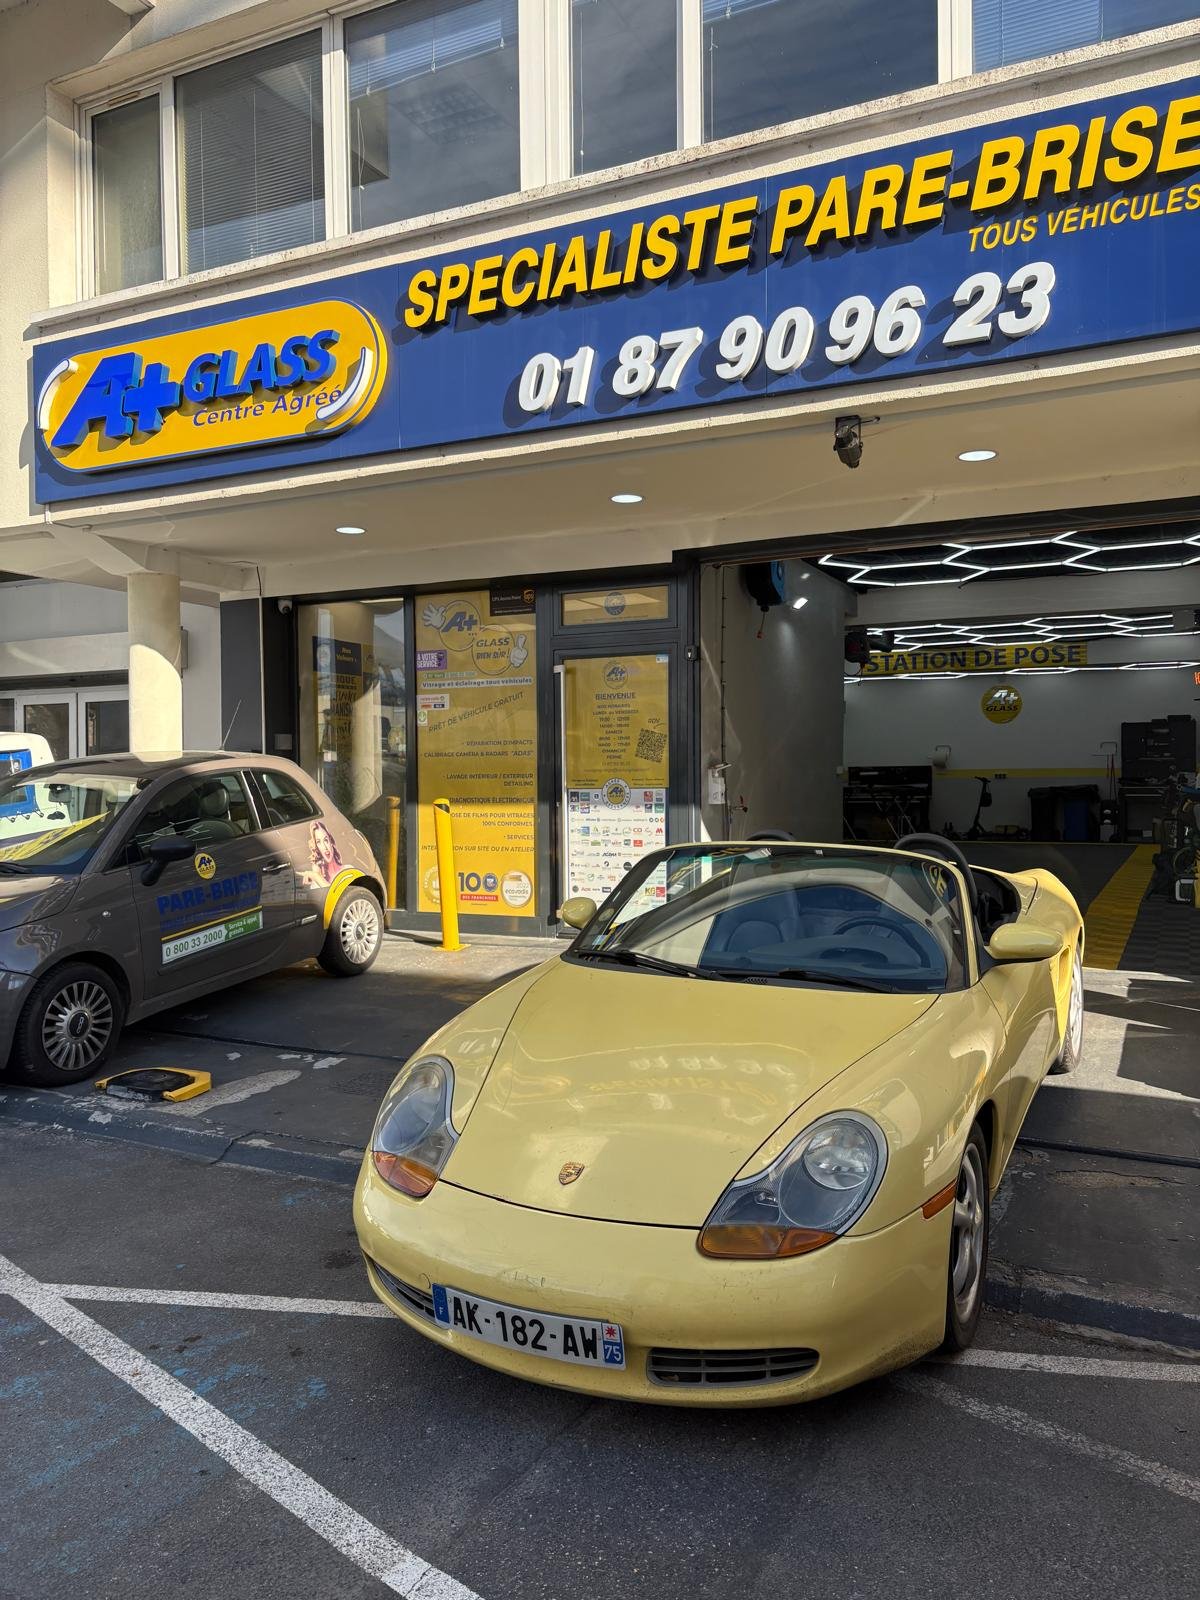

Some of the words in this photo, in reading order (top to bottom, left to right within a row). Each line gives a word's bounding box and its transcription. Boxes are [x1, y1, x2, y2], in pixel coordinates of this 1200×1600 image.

[403, 195, 759, 330] SPECIALISTE
[769, 95, 1200, 255] PARE-BRISE
[968, 215, 1038, 252] TOUS
[1047, 184, 1200, 238] VÉHICULES
[517, 344, 595, 414] 01
[611, 326, 704, 398] 87
[715, 306, 815, 382] 90
[825, 284, 926, 366] 96
[942, 261, 1057, 347] 23
[50, 351, 182, 448] A+
[183, 329, 341, 404] GLASS
[192, 404, 265, 427] Centre
[272, 383, 344, 416] Agréé
[476, 636, 510, 647] GLASS
[866, 650, 968, 672] STATION
[974, 648, 1007, 667] DE
[1014, 645, 1081, 665] POSE
[447, 716, 458, 726] DE
[493, 691, 524, 708] GRATUIT
[595, 692, 637, 701] BIENVENUE
[165, 947, 171, 957] 0
[173, 941, 190, 955] 800
[191, 938, 201, 949] 33
[203, 929, 223, 944] 2000
[438, 1307, 444, 1315] F
[453, 1296, 598, 1360] AK-182-AW
[604, 1344, 622, 1362] 75
